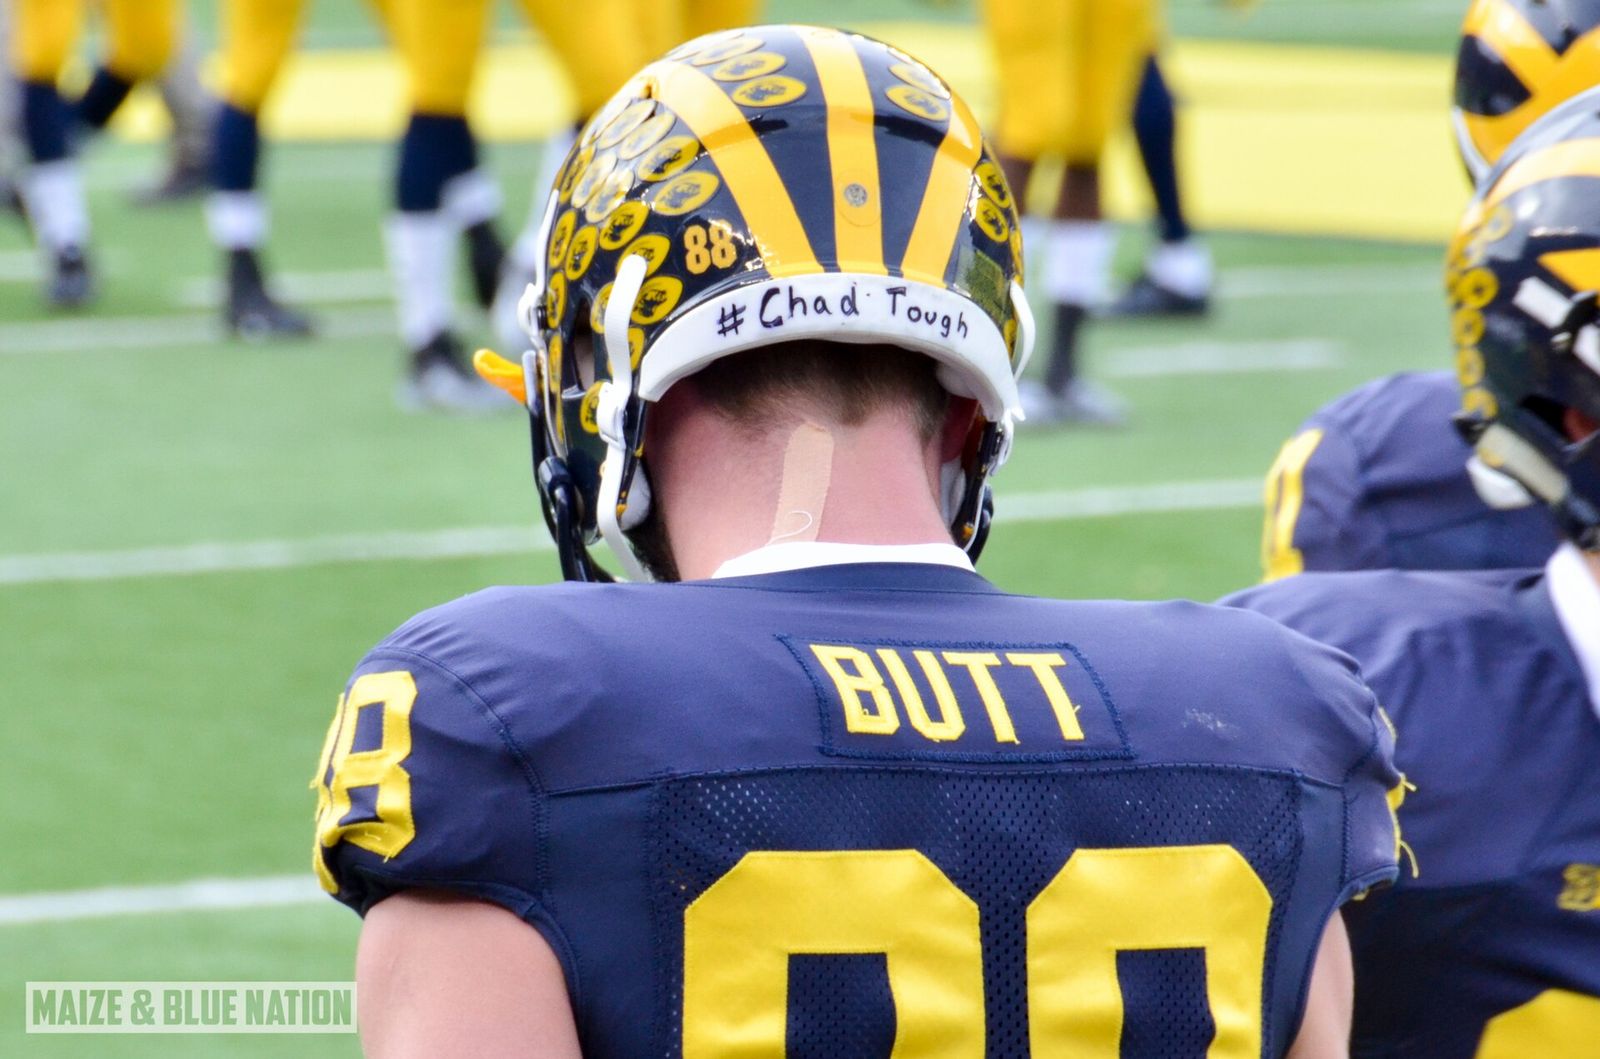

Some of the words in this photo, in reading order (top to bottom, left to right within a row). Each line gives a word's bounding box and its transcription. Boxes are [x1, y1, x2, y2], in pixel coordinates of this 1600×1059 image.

[683, 220, 737, 275] 88
[886, 286, 969, 339] Tough
[809, 644, 1084, 744] BUTT
